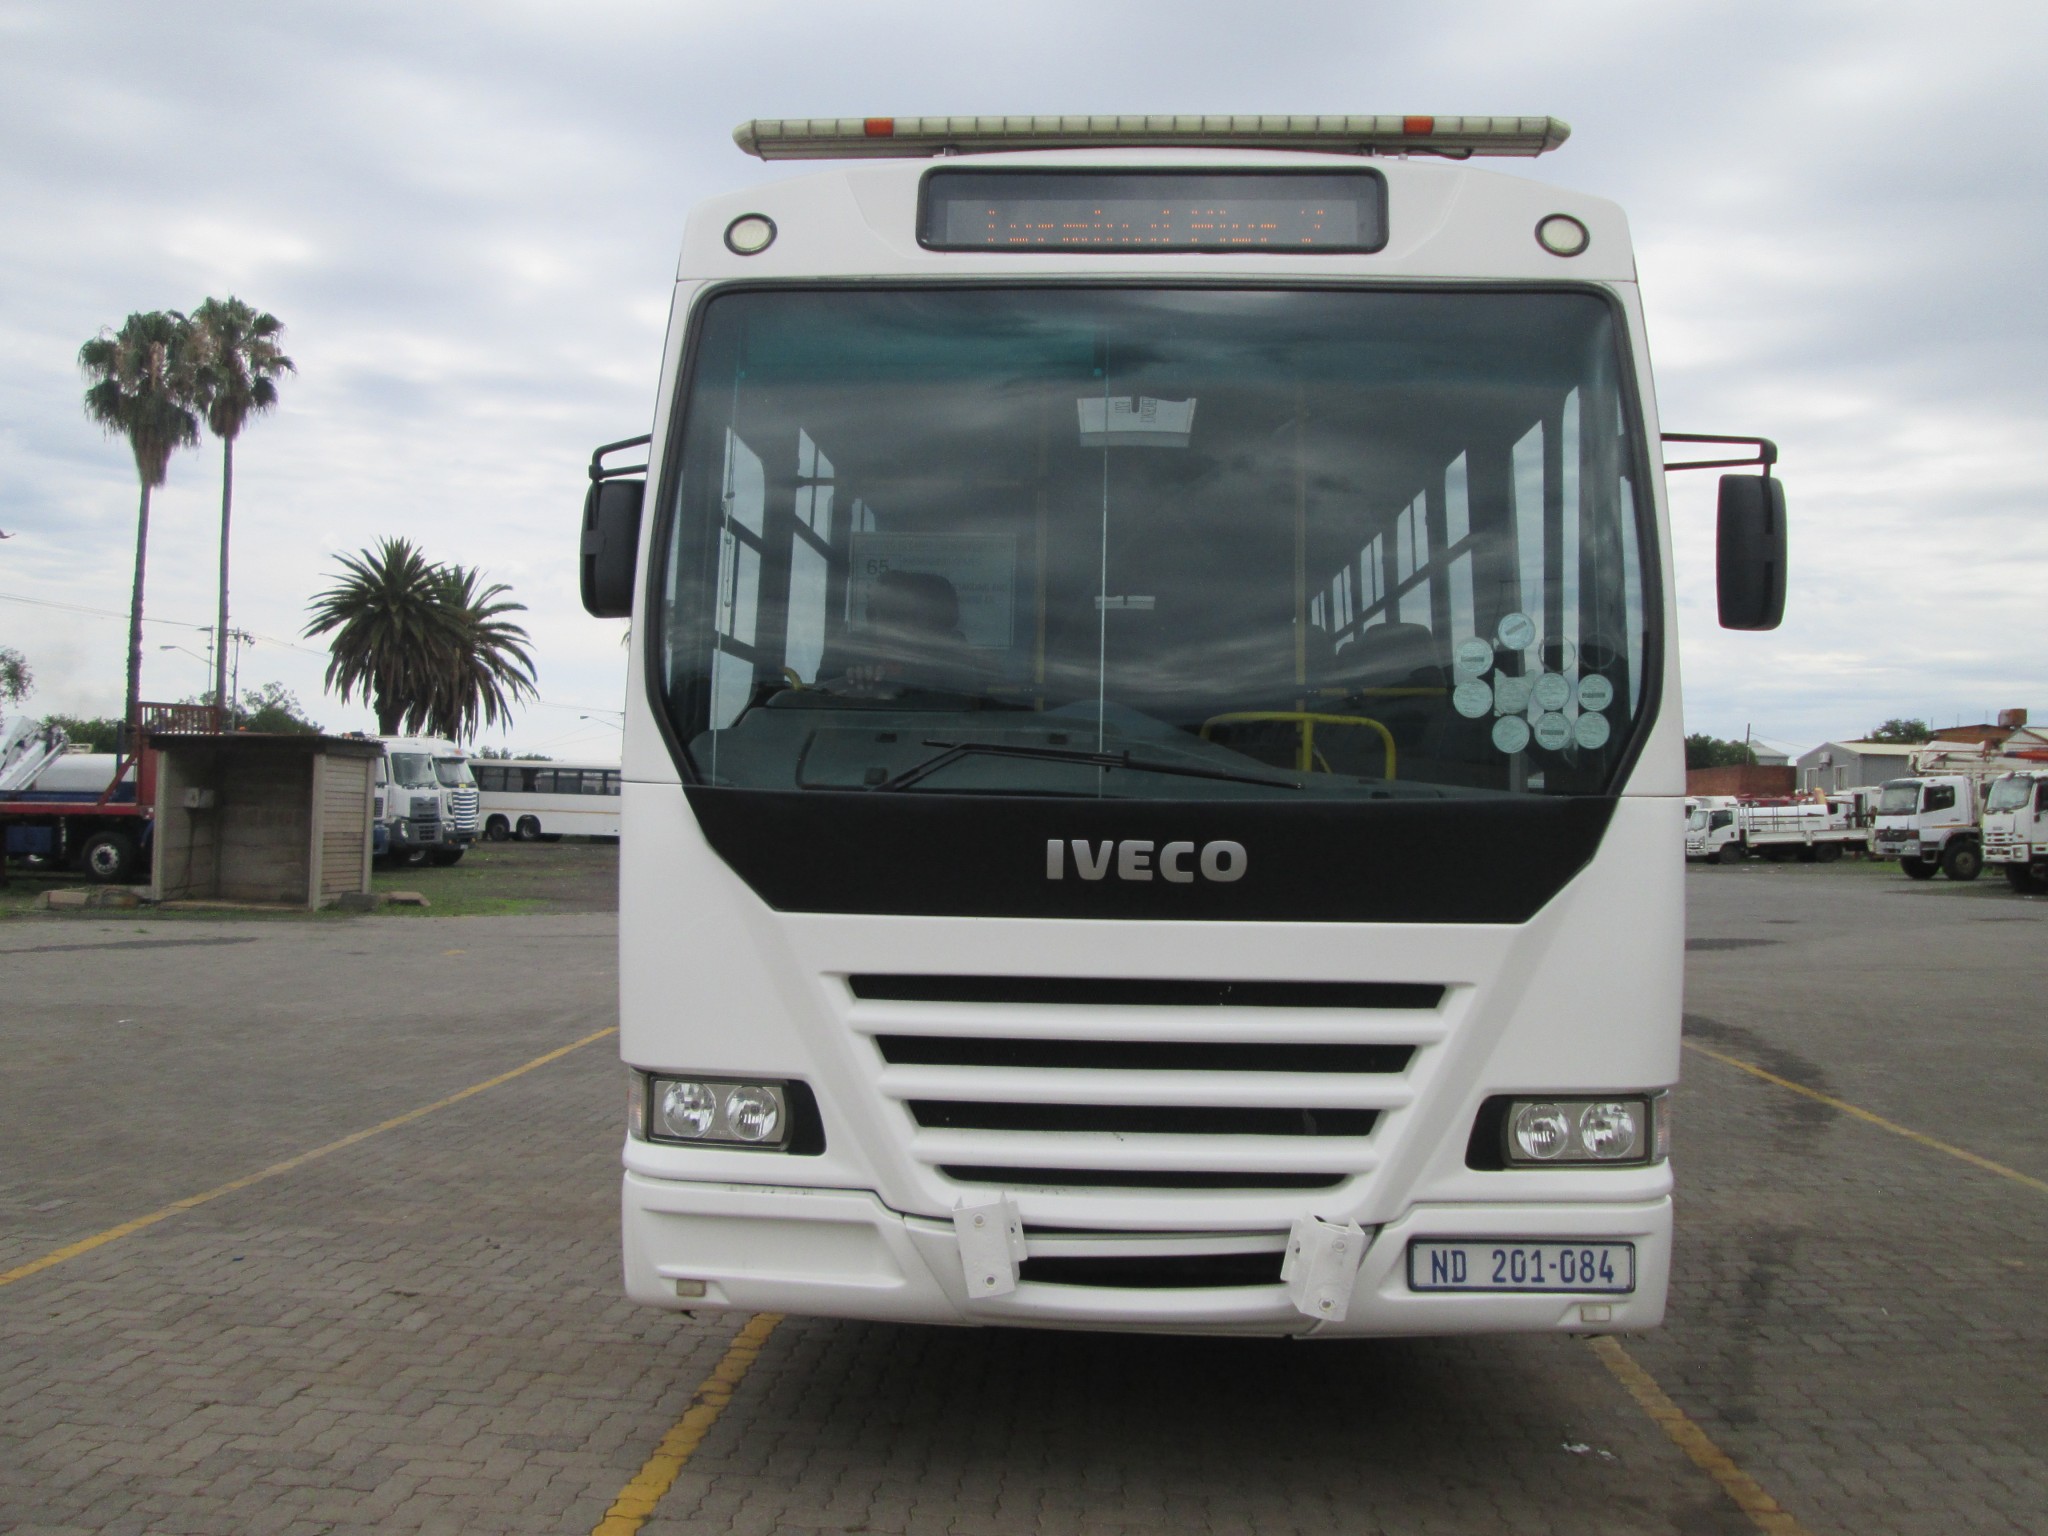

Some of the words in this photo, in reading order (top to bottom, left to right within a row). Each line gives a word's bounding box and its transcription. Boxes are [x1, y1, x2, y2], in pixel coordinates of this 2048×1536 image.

[866, 559, 889, 575] 65
[1046, 839, 1248, 883] IVECO
[1431, 1249, 1467, 1284] ND
[1492, 1249, 1615, 1284] 201-084
